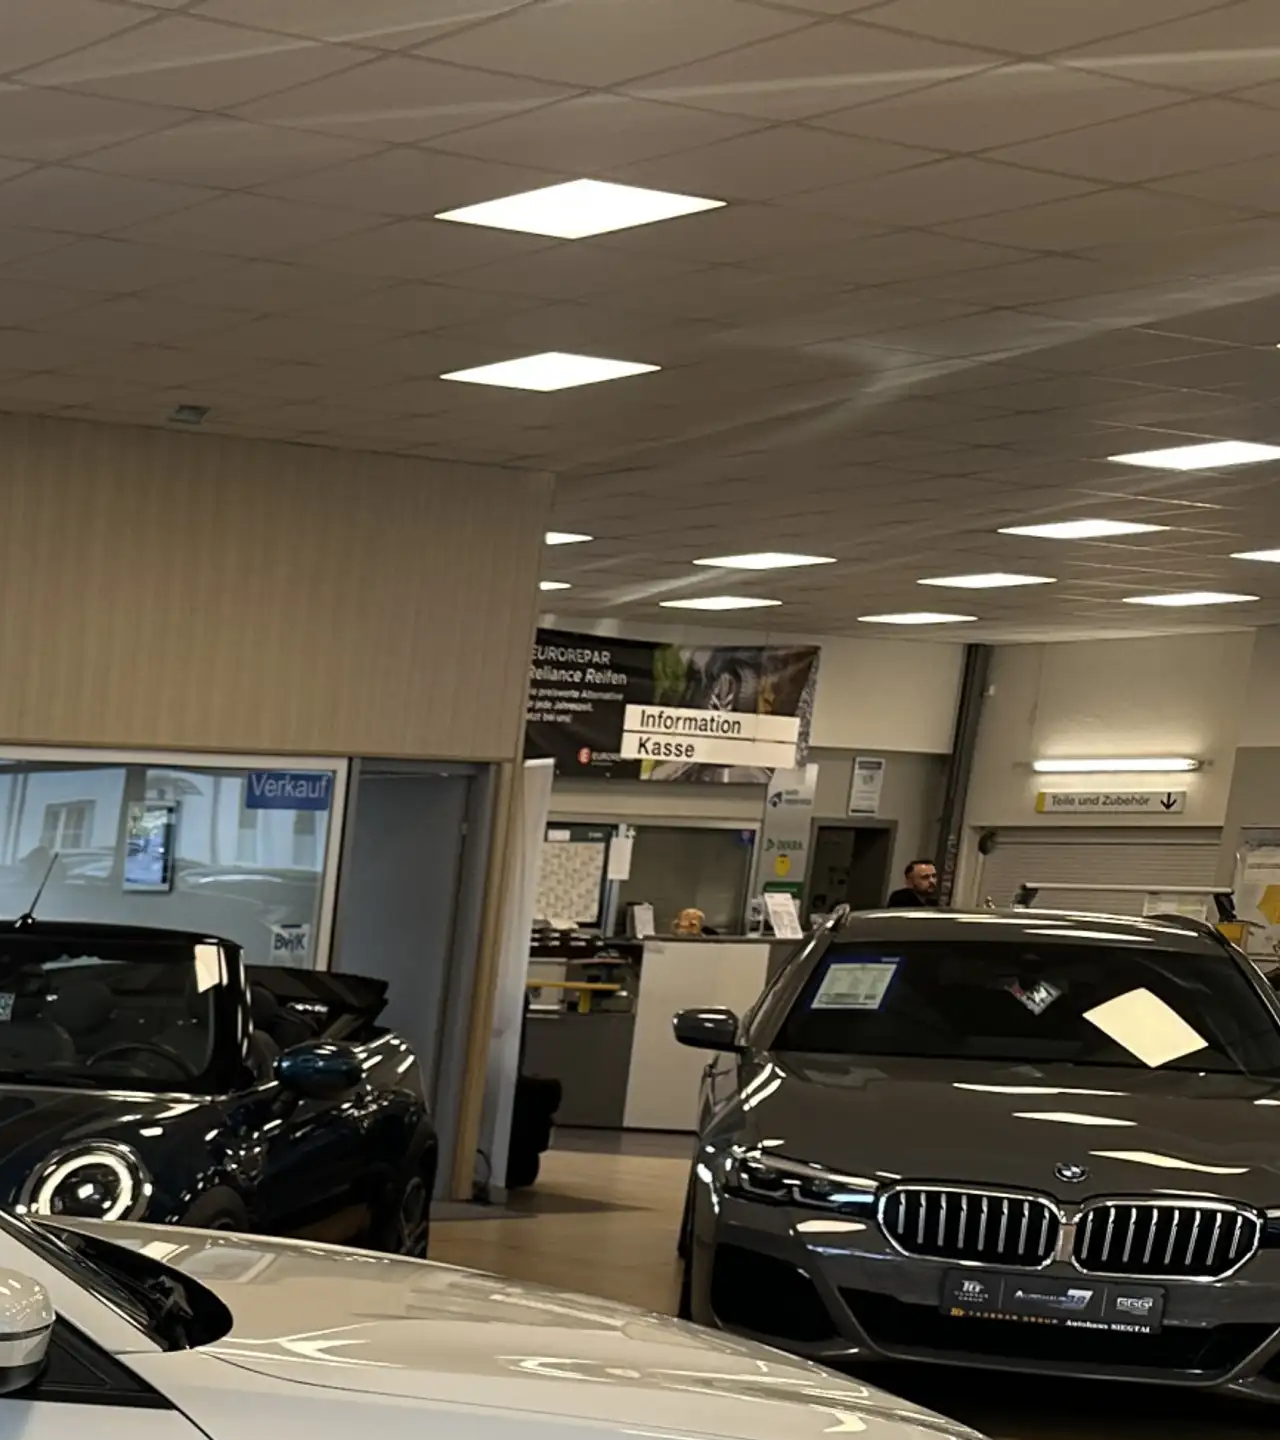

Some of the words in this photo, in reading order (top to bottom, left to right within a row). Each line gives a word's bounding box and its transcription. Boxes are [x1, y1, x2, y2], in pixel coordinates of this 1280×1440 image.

[584, 668, 627, 686] Reifen
[640, 709, 741, 735] Information
[638, 736, 695, 758] Kasse
[251, 773, 328, 798] Verkauf
[1051, 795, 1075, 806] Teile
[1078, 795, 1100, 806] und
[1101, 795, 1150, 806] Zubehör
[1065, 1319, 1108, 1331] Autohaus
